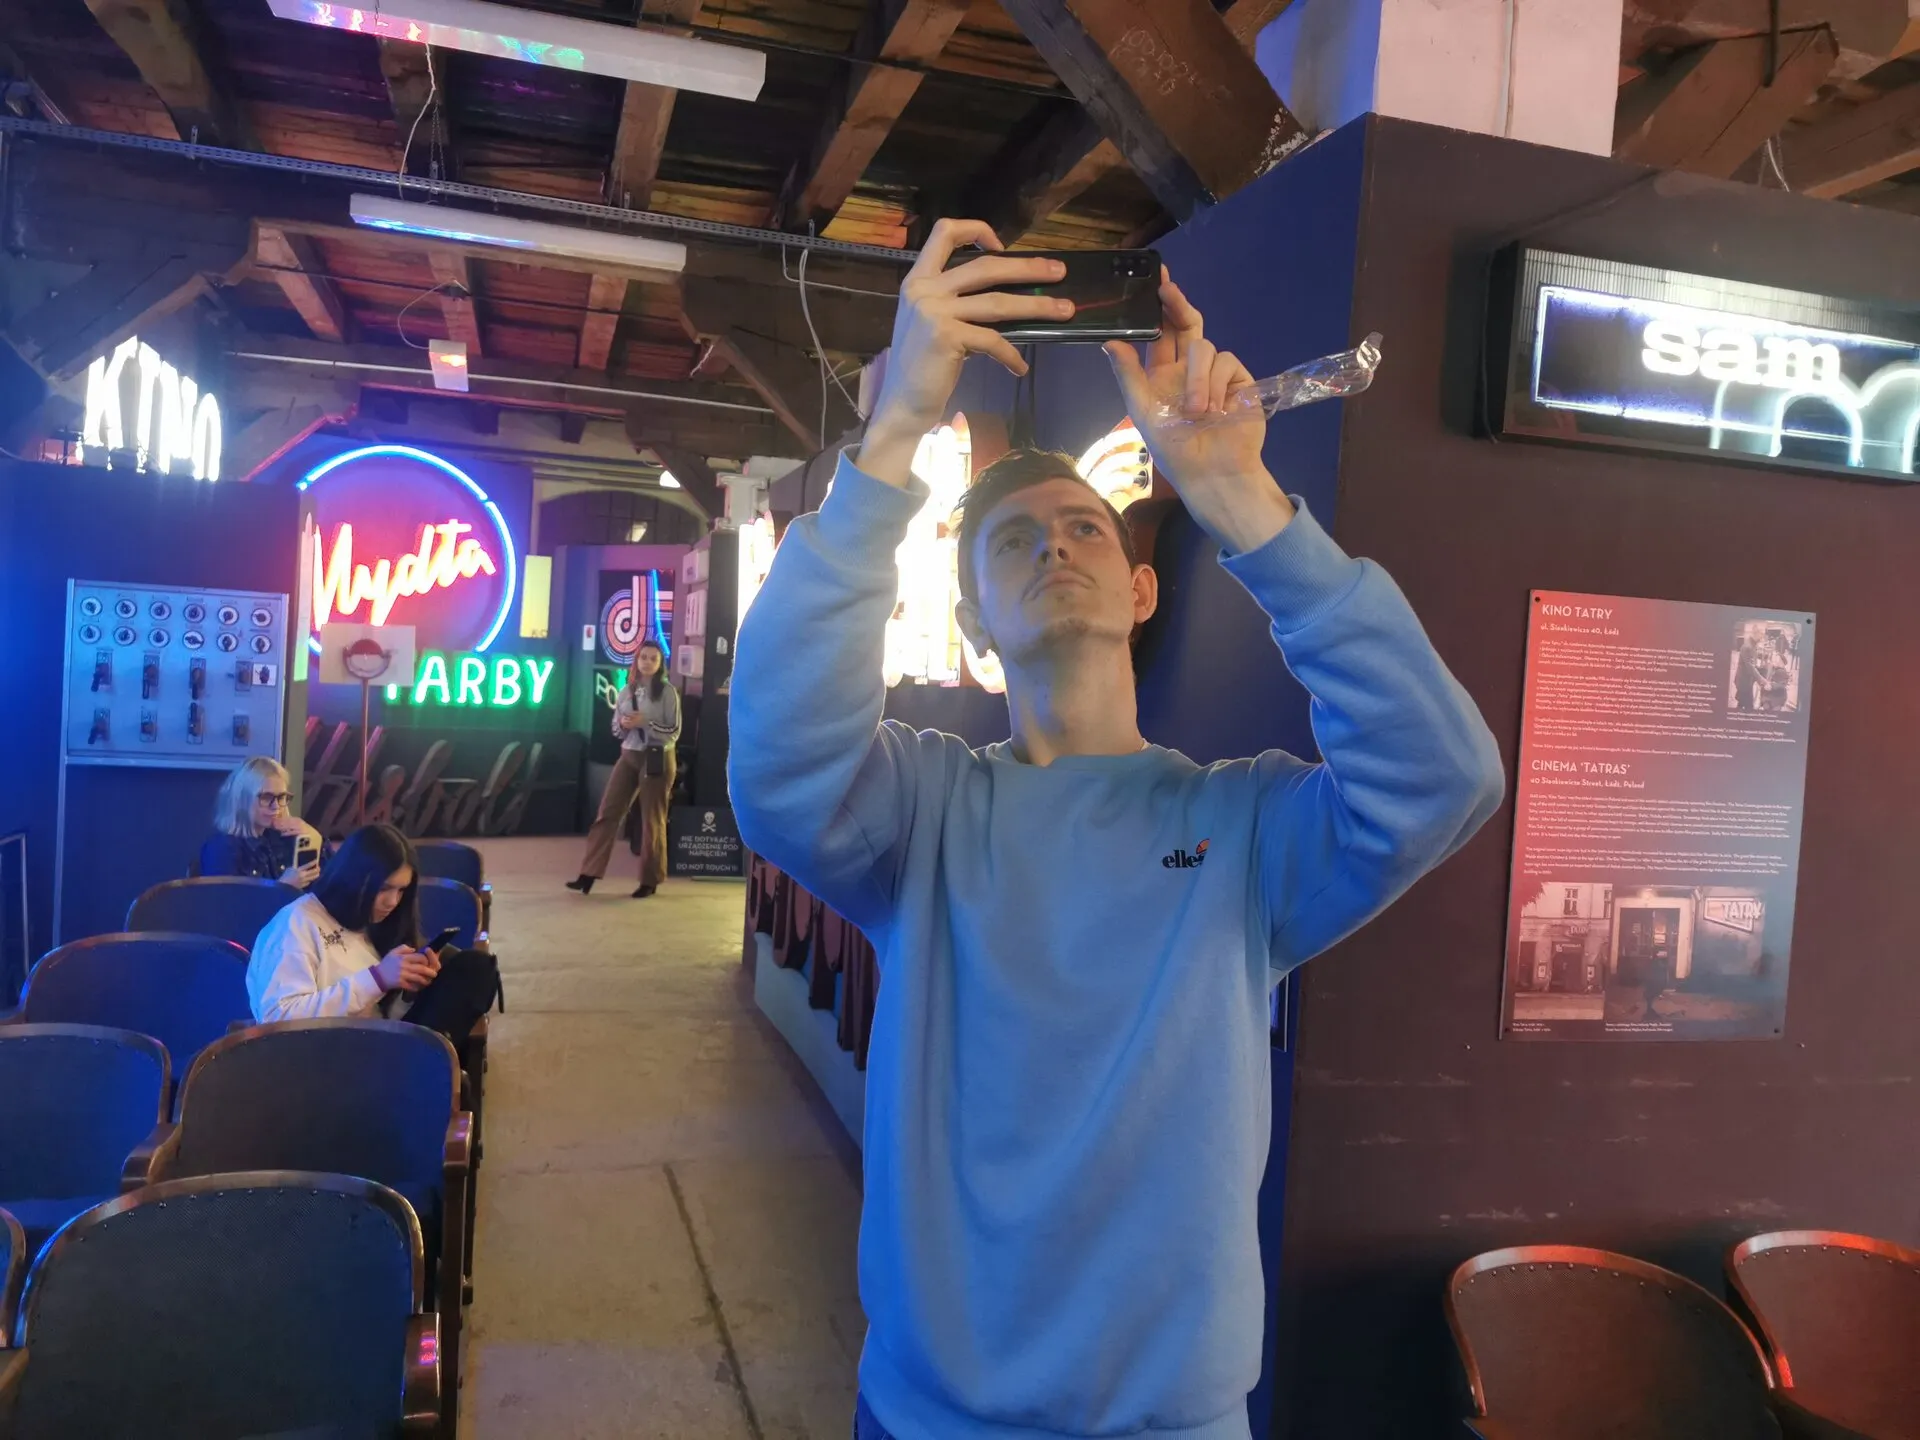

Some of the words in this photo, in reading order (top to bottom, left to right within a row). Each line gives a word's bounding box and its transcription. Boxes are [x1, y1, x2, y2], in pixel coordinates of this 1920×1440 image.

[1642, 319, 1840, 393] sam
[83, 335, 222, 482] KINO
[1542, 604, 1572, 618] KINO
[1575, 606, 1613, 620] TATRY
[386, 655, 554, 705] ARBY
[1531, 759, 1578, 773] CINEMA
[1623, 781, 1645, 789] Poland
